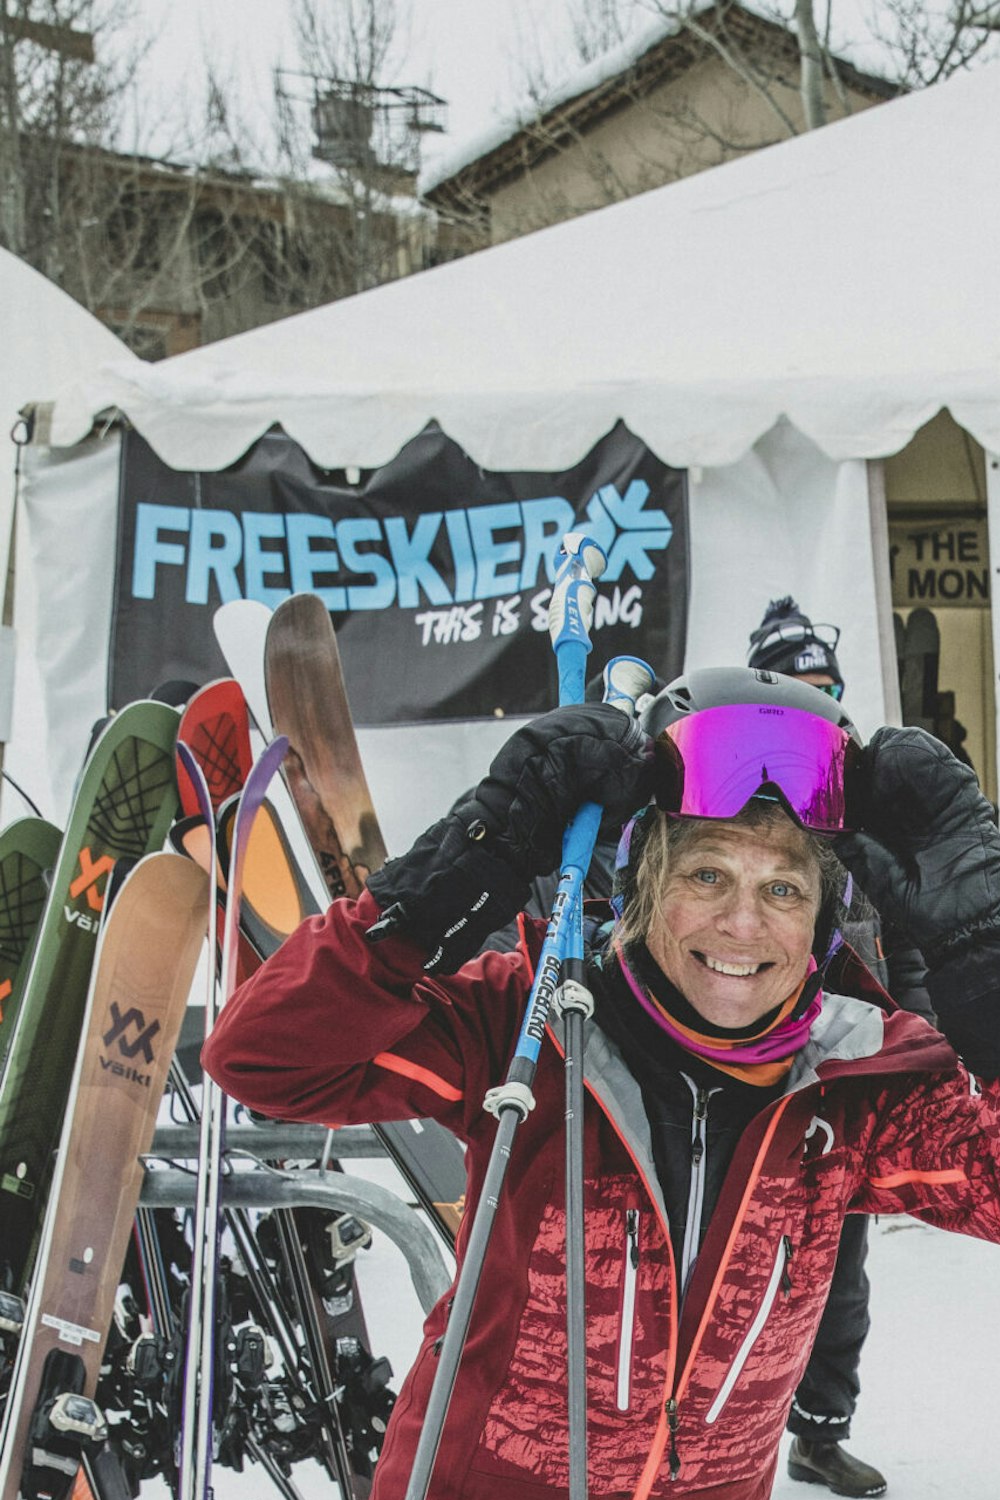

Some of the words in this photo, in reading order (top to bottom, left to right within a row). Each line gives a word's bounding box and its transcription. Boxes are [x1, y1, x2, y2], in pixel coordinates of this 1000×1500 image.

[132, 496, 576, 611] FREESKIER
[907, 530, 980, 562] THE
[908, 568, 989, 599] MON
[415, 602, 484, 646] THIS
[530, 584, 643, 633] SNG
[566, 596, 581, 635] LEKI
[64, 905, 99, 934] Völ
[526, 955, 562, 1042] BLUEBIRD
